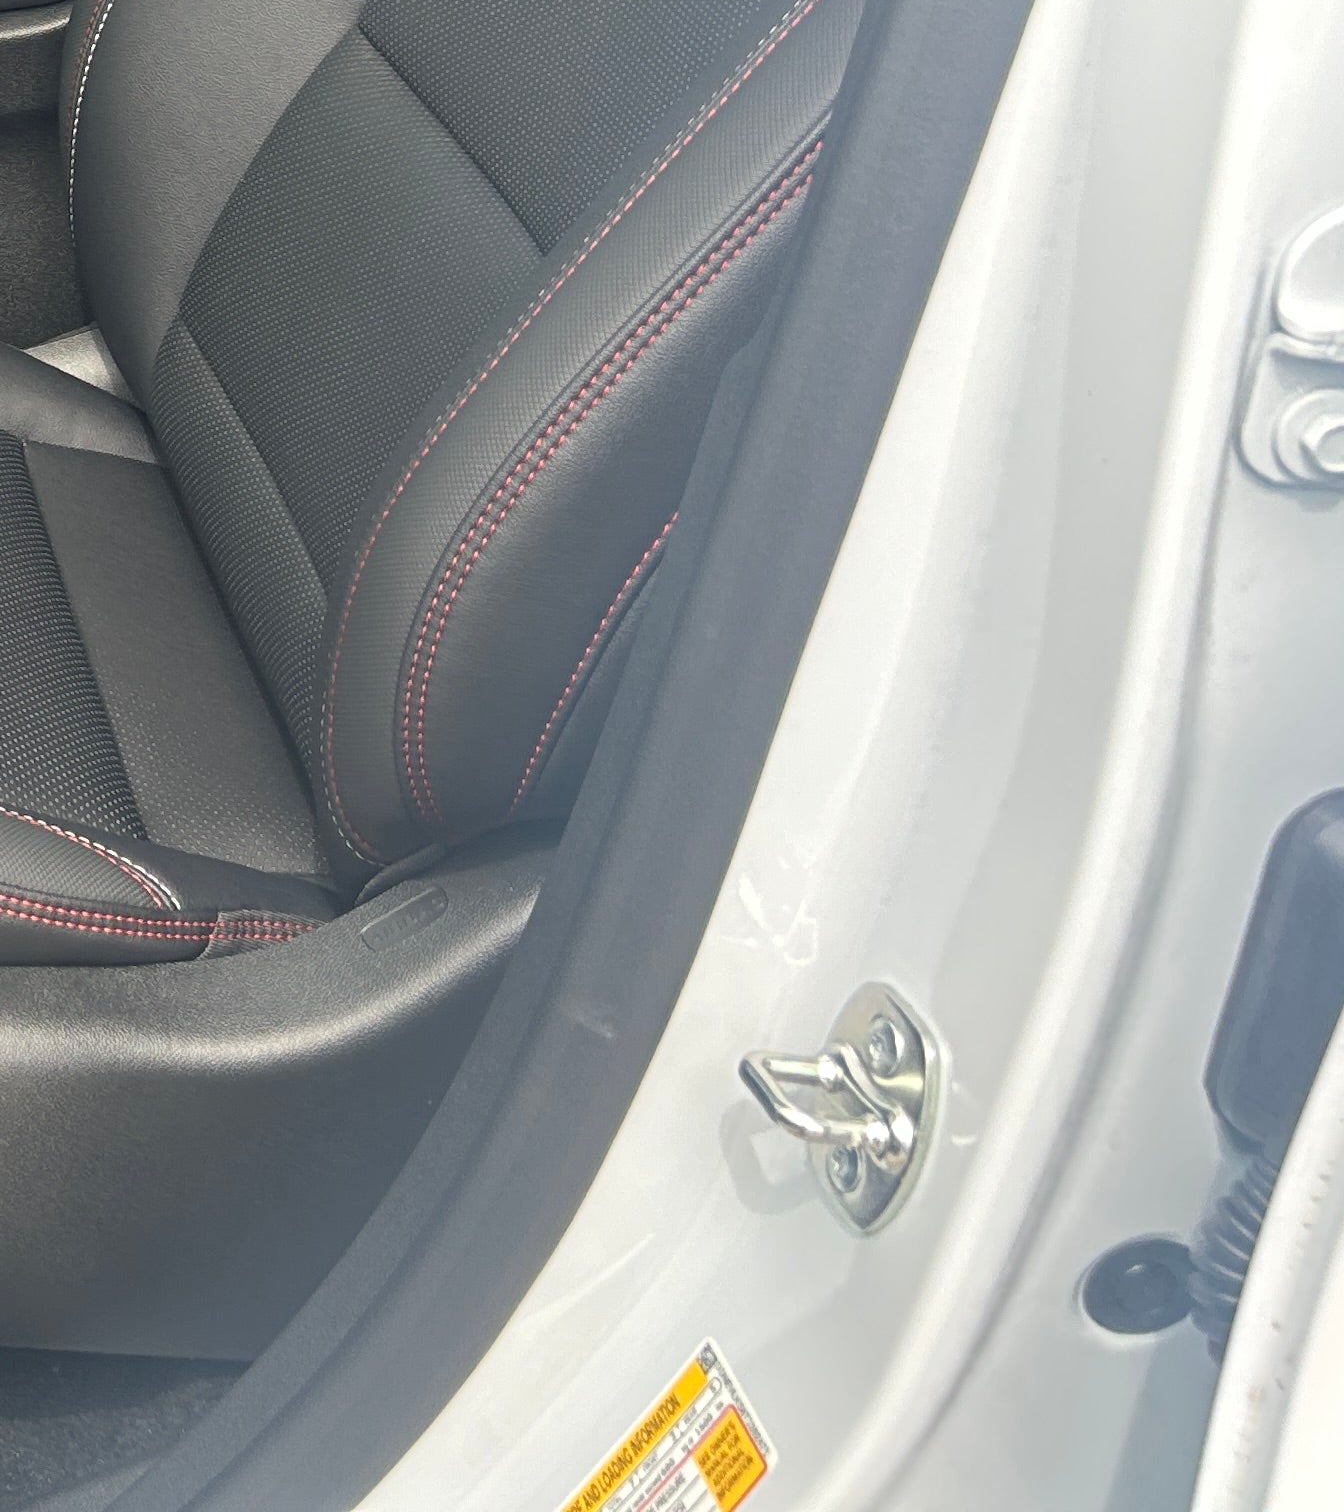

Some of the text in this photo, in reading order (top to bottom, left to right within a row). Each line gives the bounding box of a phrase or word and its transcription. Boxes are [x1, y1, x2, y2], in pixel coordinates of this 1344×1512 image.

[581, 1391, 681, 1511] AND LOADING INFORMATION
